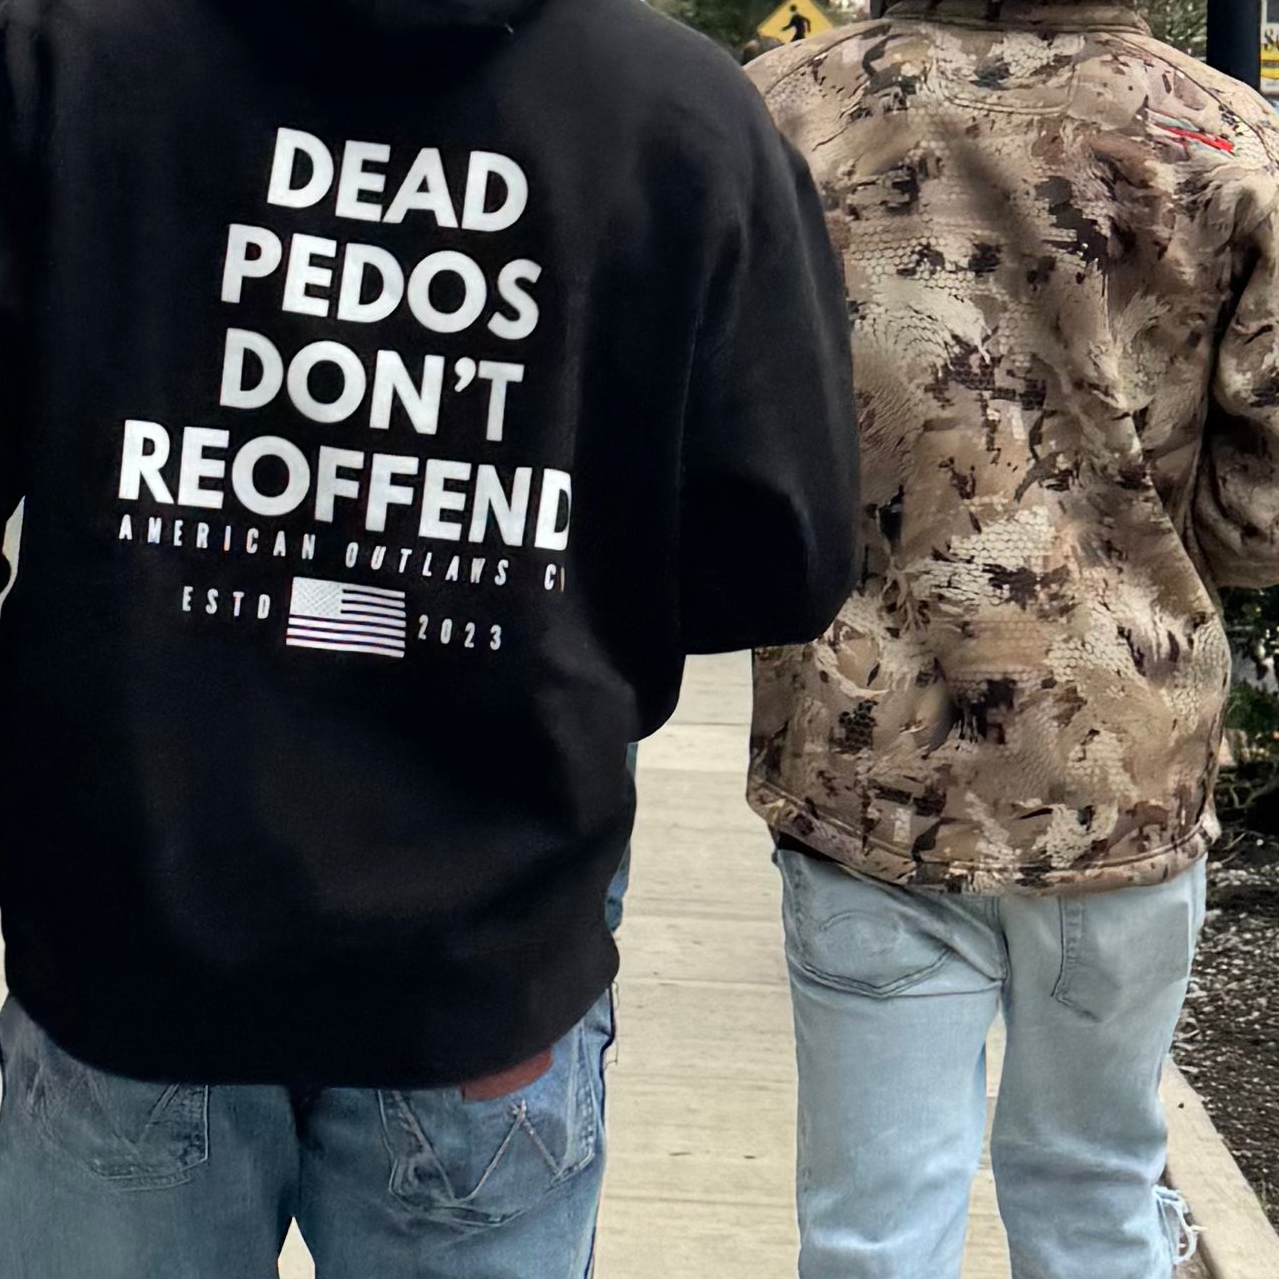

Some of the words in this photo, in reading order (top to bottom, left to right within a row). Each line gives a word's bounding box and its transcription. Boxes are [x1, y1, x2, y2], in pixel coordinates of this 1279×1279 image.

[266, 126, 529, 233] DEAD
[220, 222, 543, 341] PEDOS
[219, 326, 525, 443] DON'T
[117, 418, 573, 552] REOFFEND
[118, 512, 317, 561] AMERICAN
[344, 540, 510, 587] OUTLAWS
[181, 584, 272, 620] ESTD
[417, 613, 503, 652] 2023
